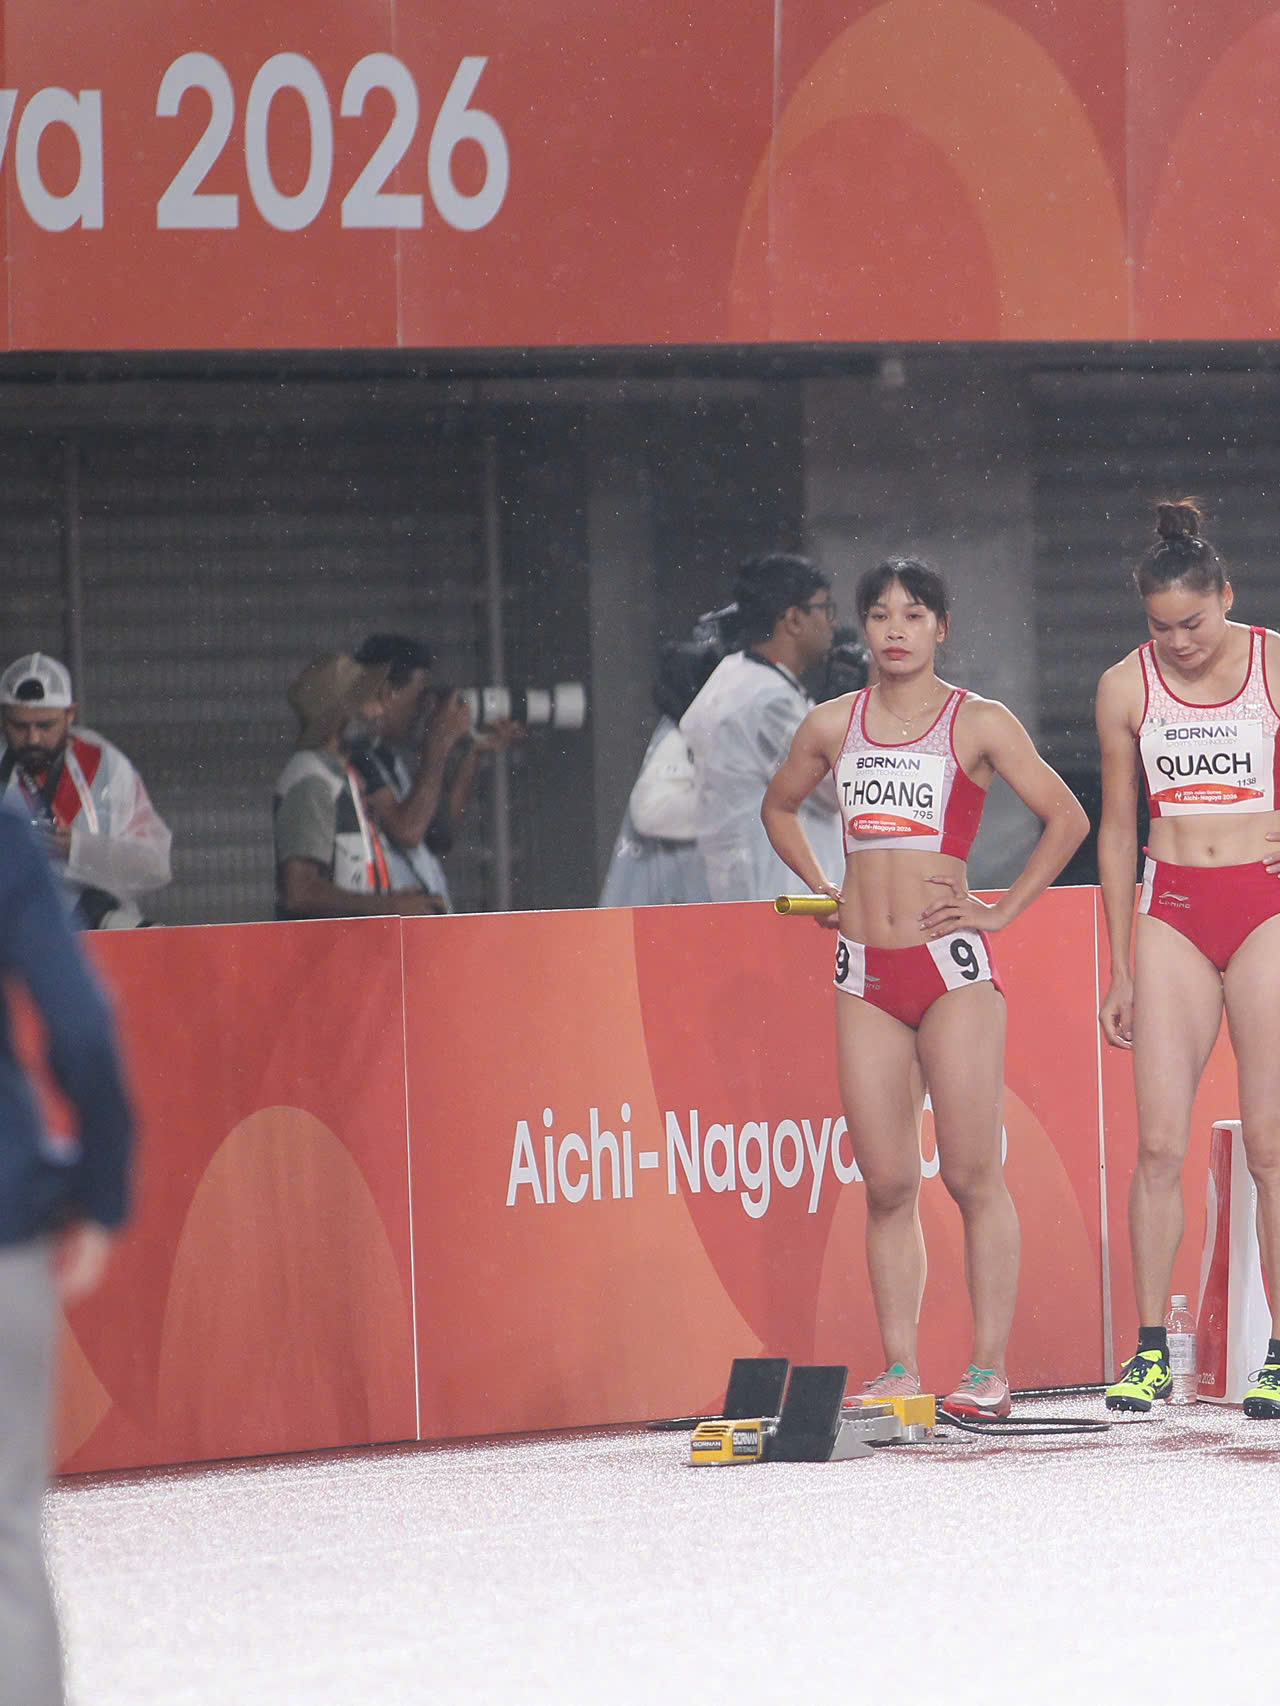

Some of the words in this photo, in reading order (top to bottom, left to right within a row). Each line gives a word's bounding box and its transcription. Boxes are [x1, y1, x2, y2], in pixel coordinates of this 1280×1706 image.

[155, 51, 510, 231] 2026
[1164, 726, 1238, 741] BORNAN
[856, 756, 920, 770] BORNAN
[1156, 752, 1251, 781] QUACH
[842, 780, 933, 808] T.HOANG
[1237, 777, 1257, 787] 1138
[912, 810, 933, 820] 795
[836, 941, 850, 984] 9
[950, 938, 979, 981] 9
[505, 1102, 864, 1219] Aichi-Nagoya
